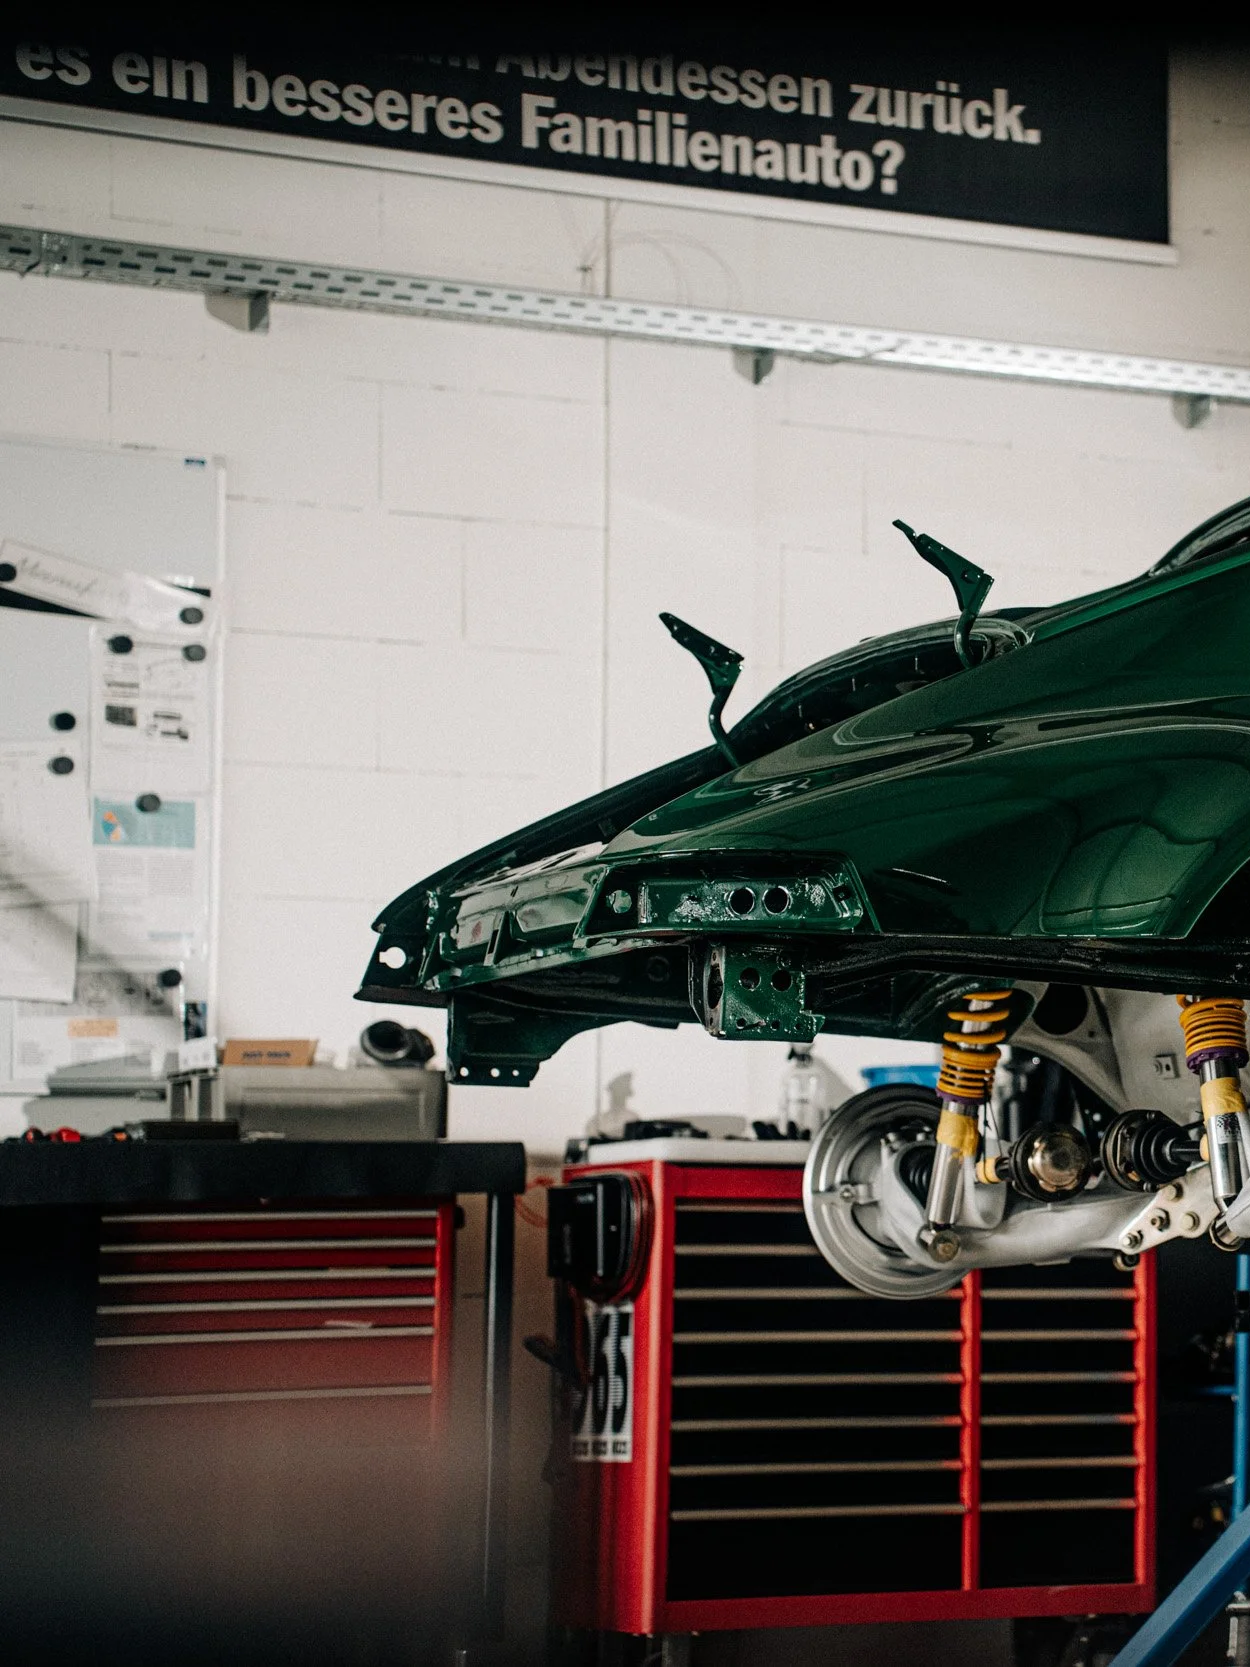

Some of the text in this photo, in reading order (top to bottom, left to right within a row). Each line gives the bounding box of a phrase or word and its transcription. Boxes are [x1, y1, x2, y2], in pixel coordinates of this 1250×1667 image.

[15, 40, 905, 195] es ein besseres Familienauto?
[848, 80, 1042, 145] zurück.
